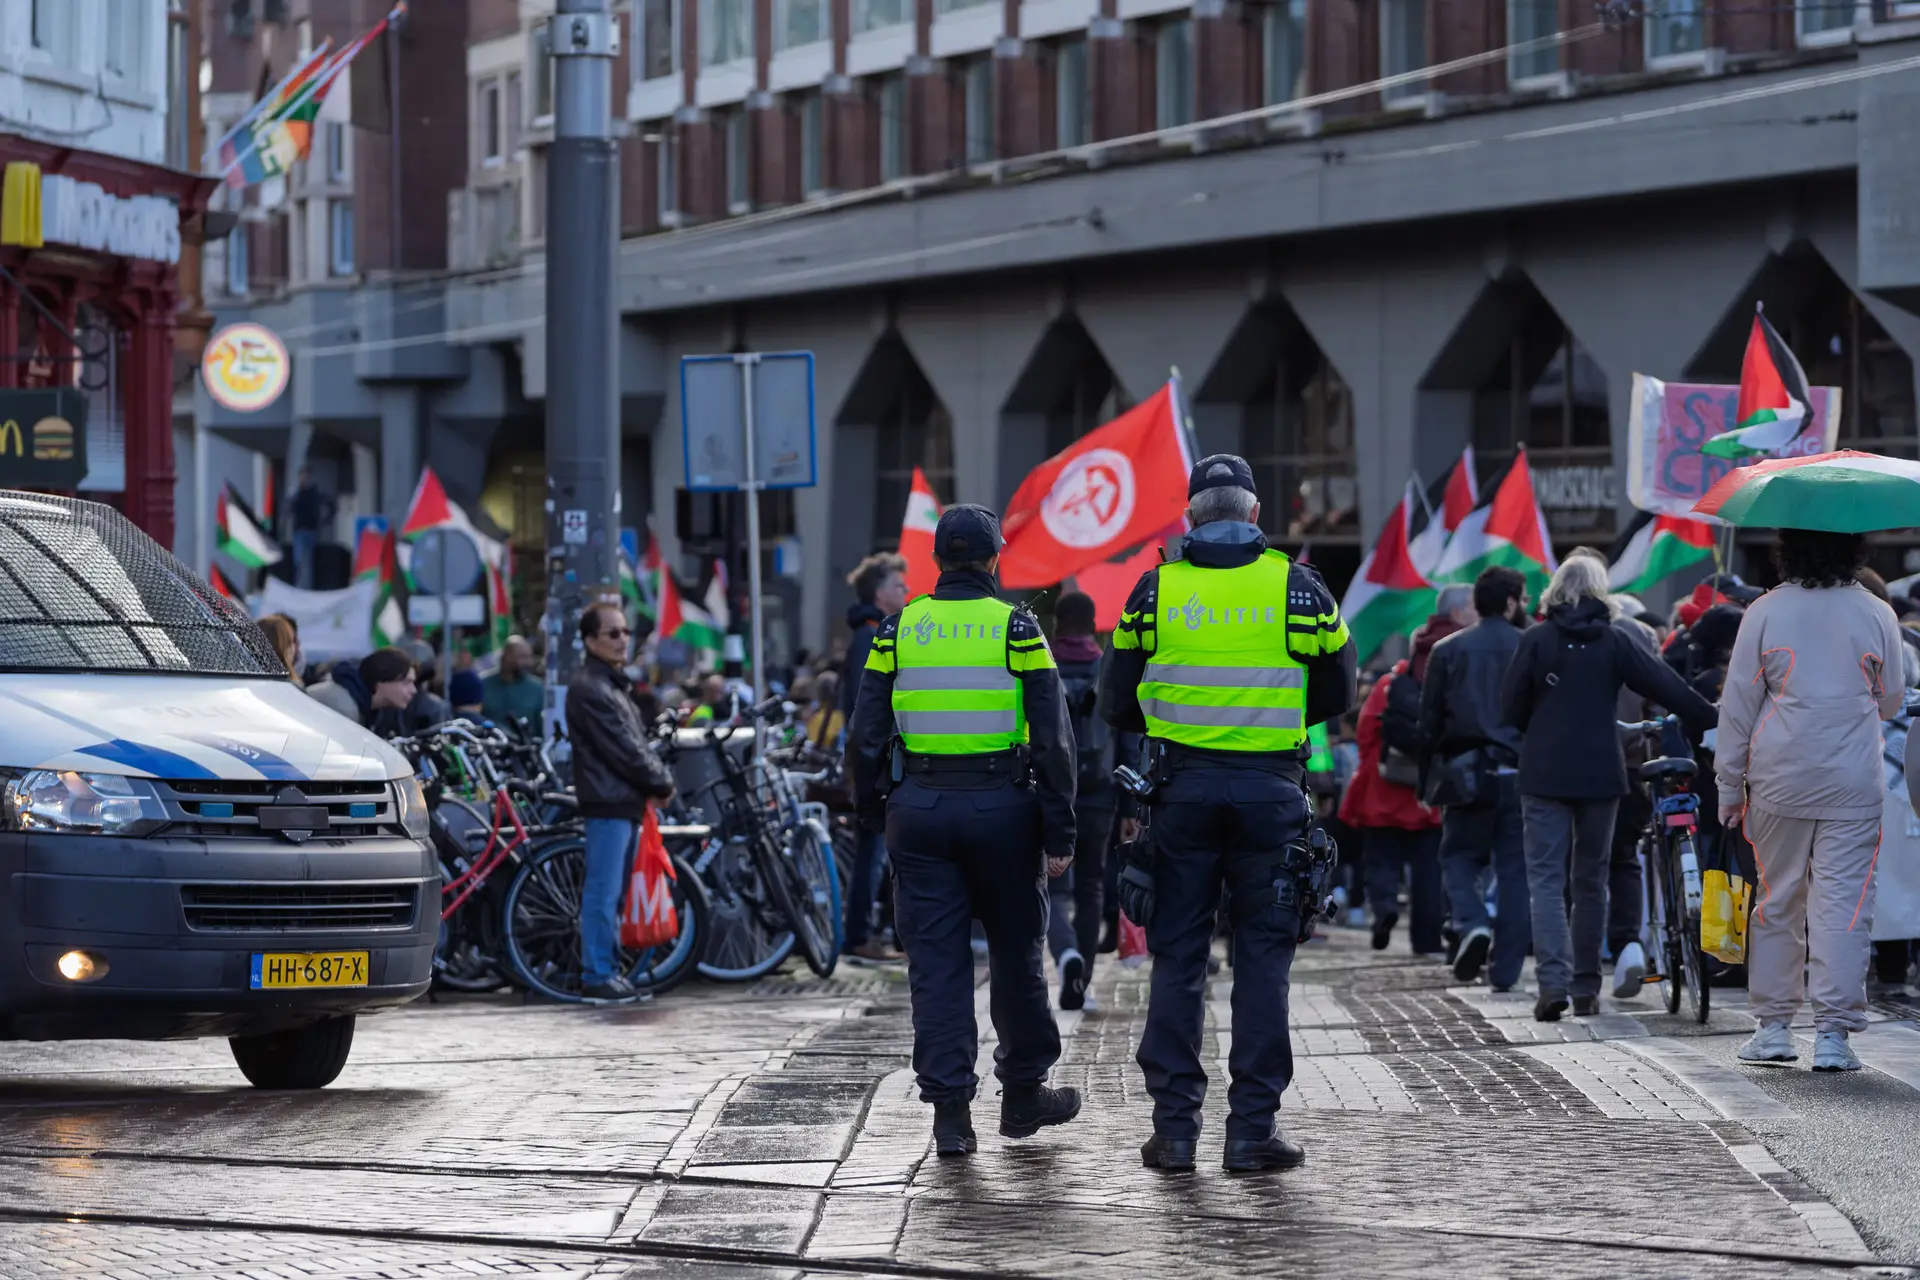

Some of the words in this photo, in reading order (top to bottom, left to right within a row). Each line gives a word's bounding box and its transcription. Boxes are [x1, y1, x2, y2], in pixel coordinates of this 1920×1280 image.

[1167, 592, 1275, 630] POLITIE
[900, 612, 1002, 645] POLITIE
[268, 956, 363, 983] HH-687-X
